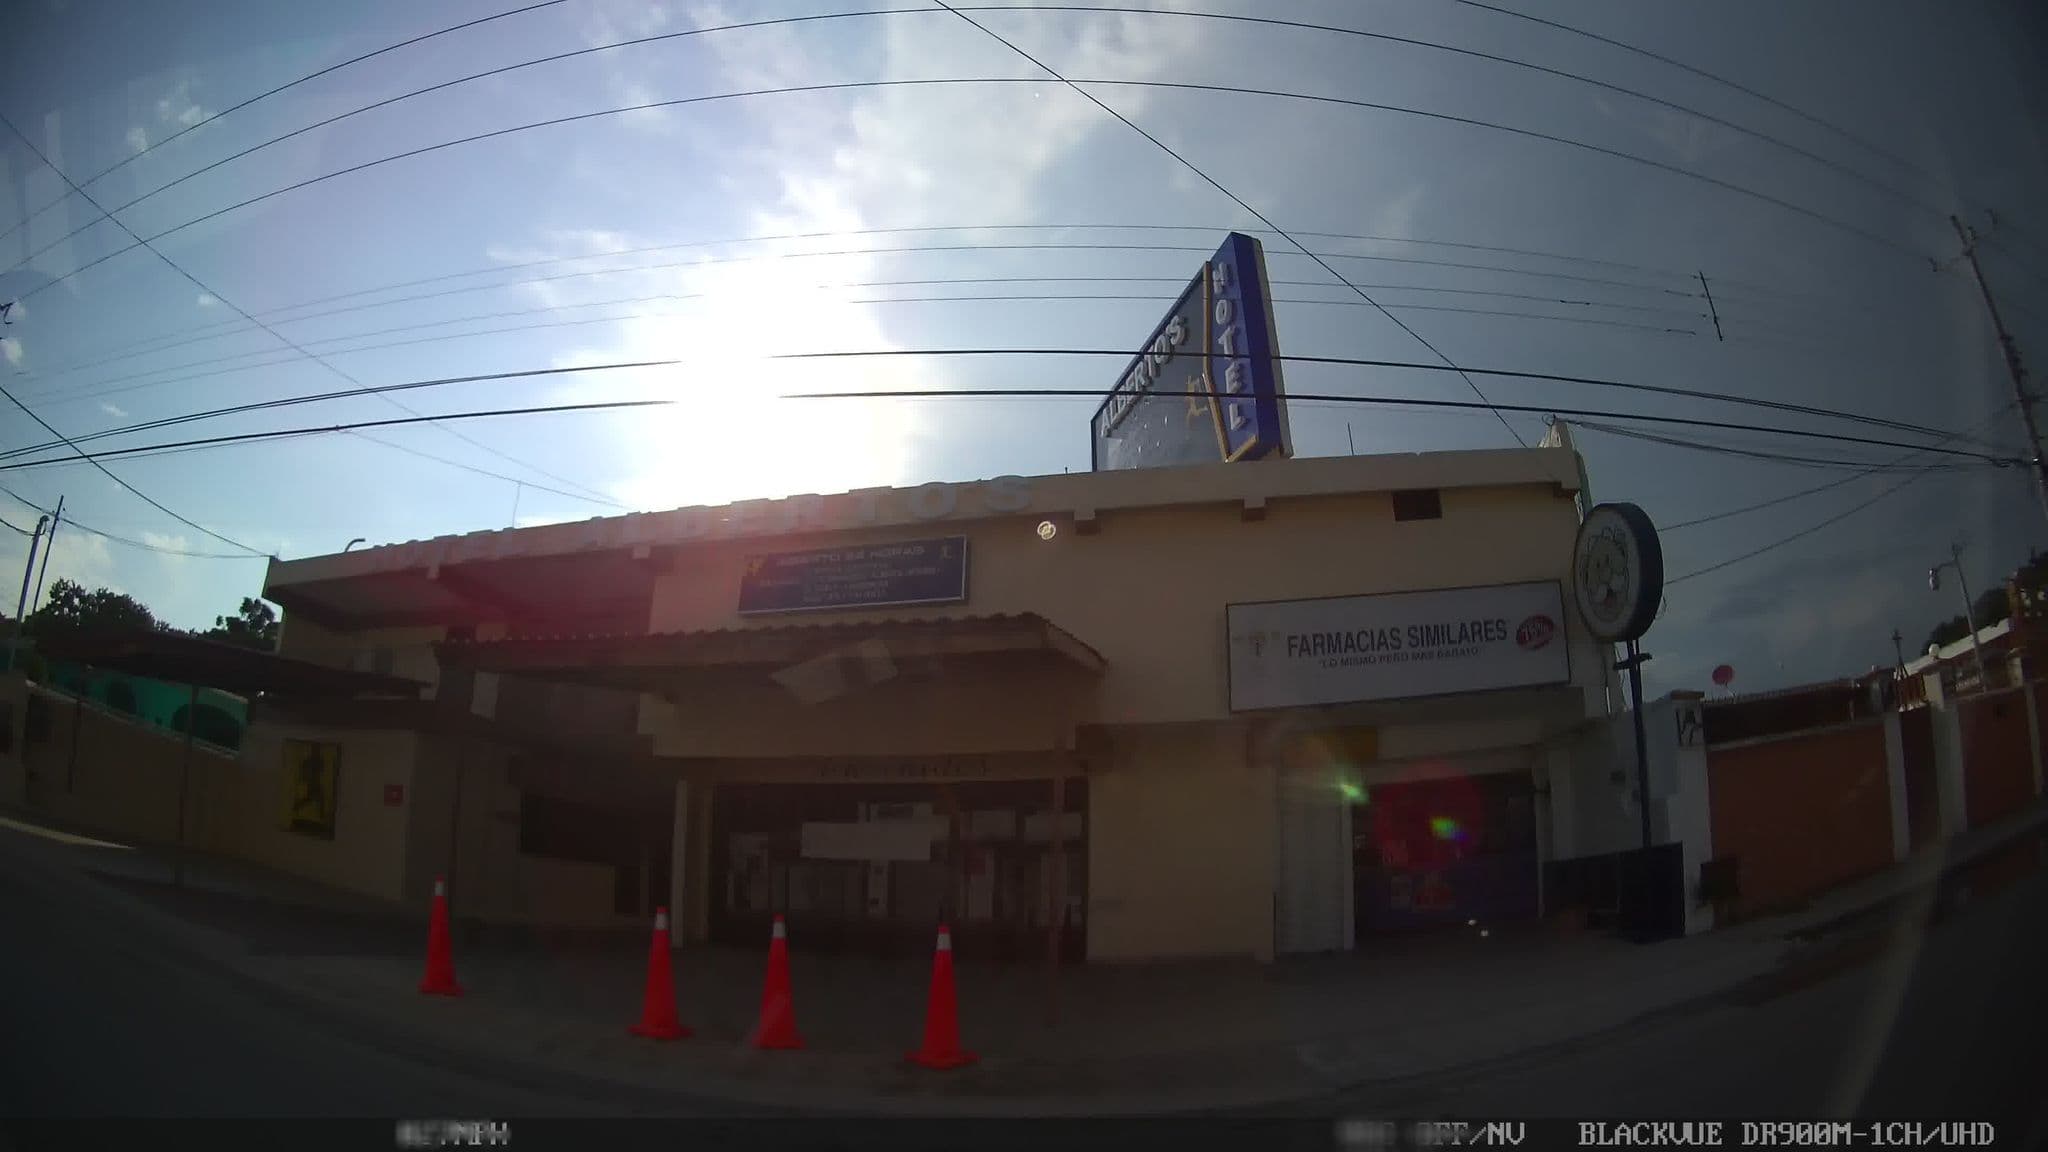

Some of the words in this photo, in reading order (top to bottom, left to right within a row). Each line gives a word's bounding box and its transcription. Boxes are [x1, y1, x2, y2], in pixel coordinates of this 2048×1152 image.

[1101, 315, 1187, 438] ALBERTOS
[1212, 261, 1247, 431] HOTEL
[1286, 627, 1402, 658] FARMACIAS
[1407, 618, 1508, 650] SIMILARES
